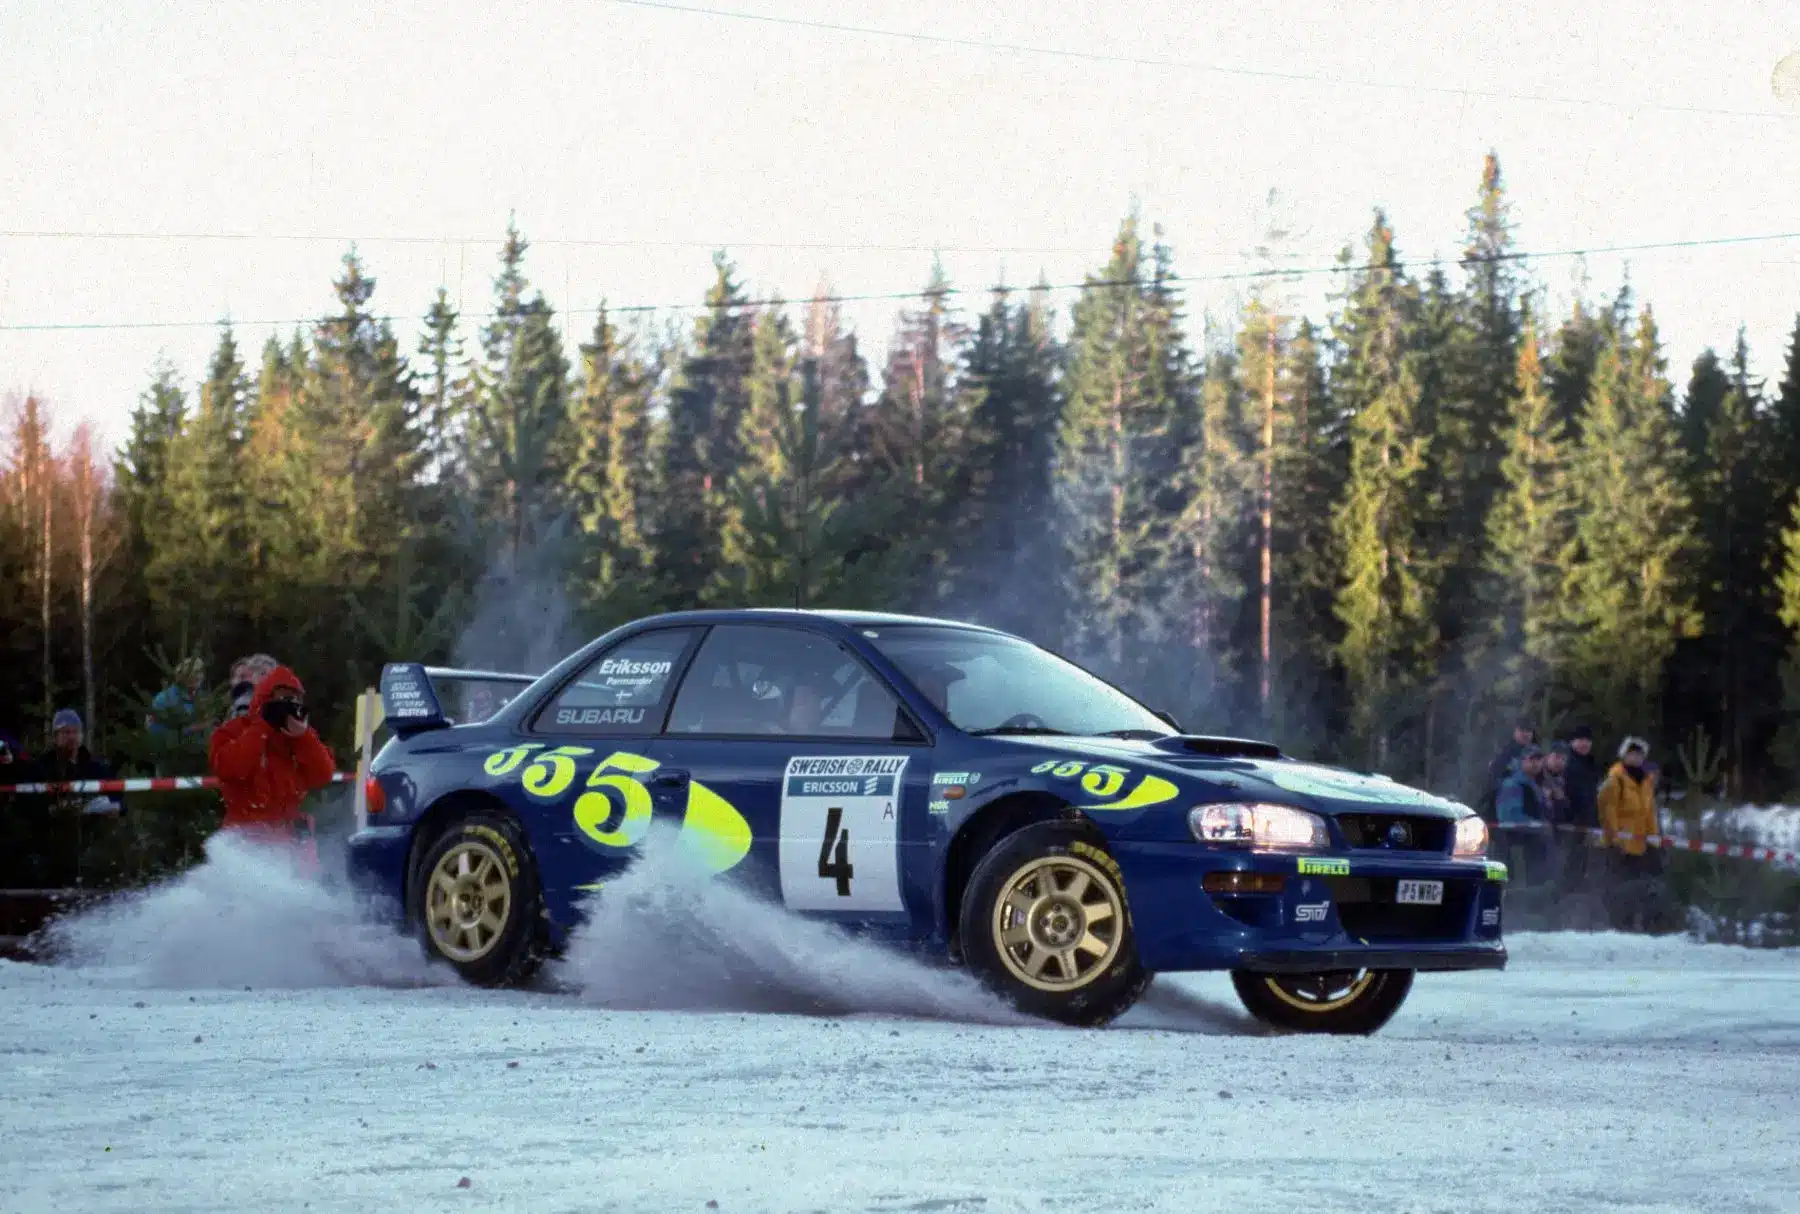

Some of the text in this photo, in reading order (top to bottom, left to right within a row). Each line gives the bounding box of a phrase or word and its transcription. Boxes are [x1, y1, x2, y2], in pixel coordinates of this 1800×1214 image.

[599, 658, 672, 675] Eriksson
[556, 708, 646, 725] SUBARU
[790, 759, 904, 775] SWEDISH RALLY
[933, 771, 969, 785] PIRELLI
[1030, 760, 1131, 796] 555
[803, 781, 858, 793] ERICSSON
[883, 802, 894, 820] A
[818, 807, 854, 896] 4
[1297, 857, 1350, 876] PIRELLI
